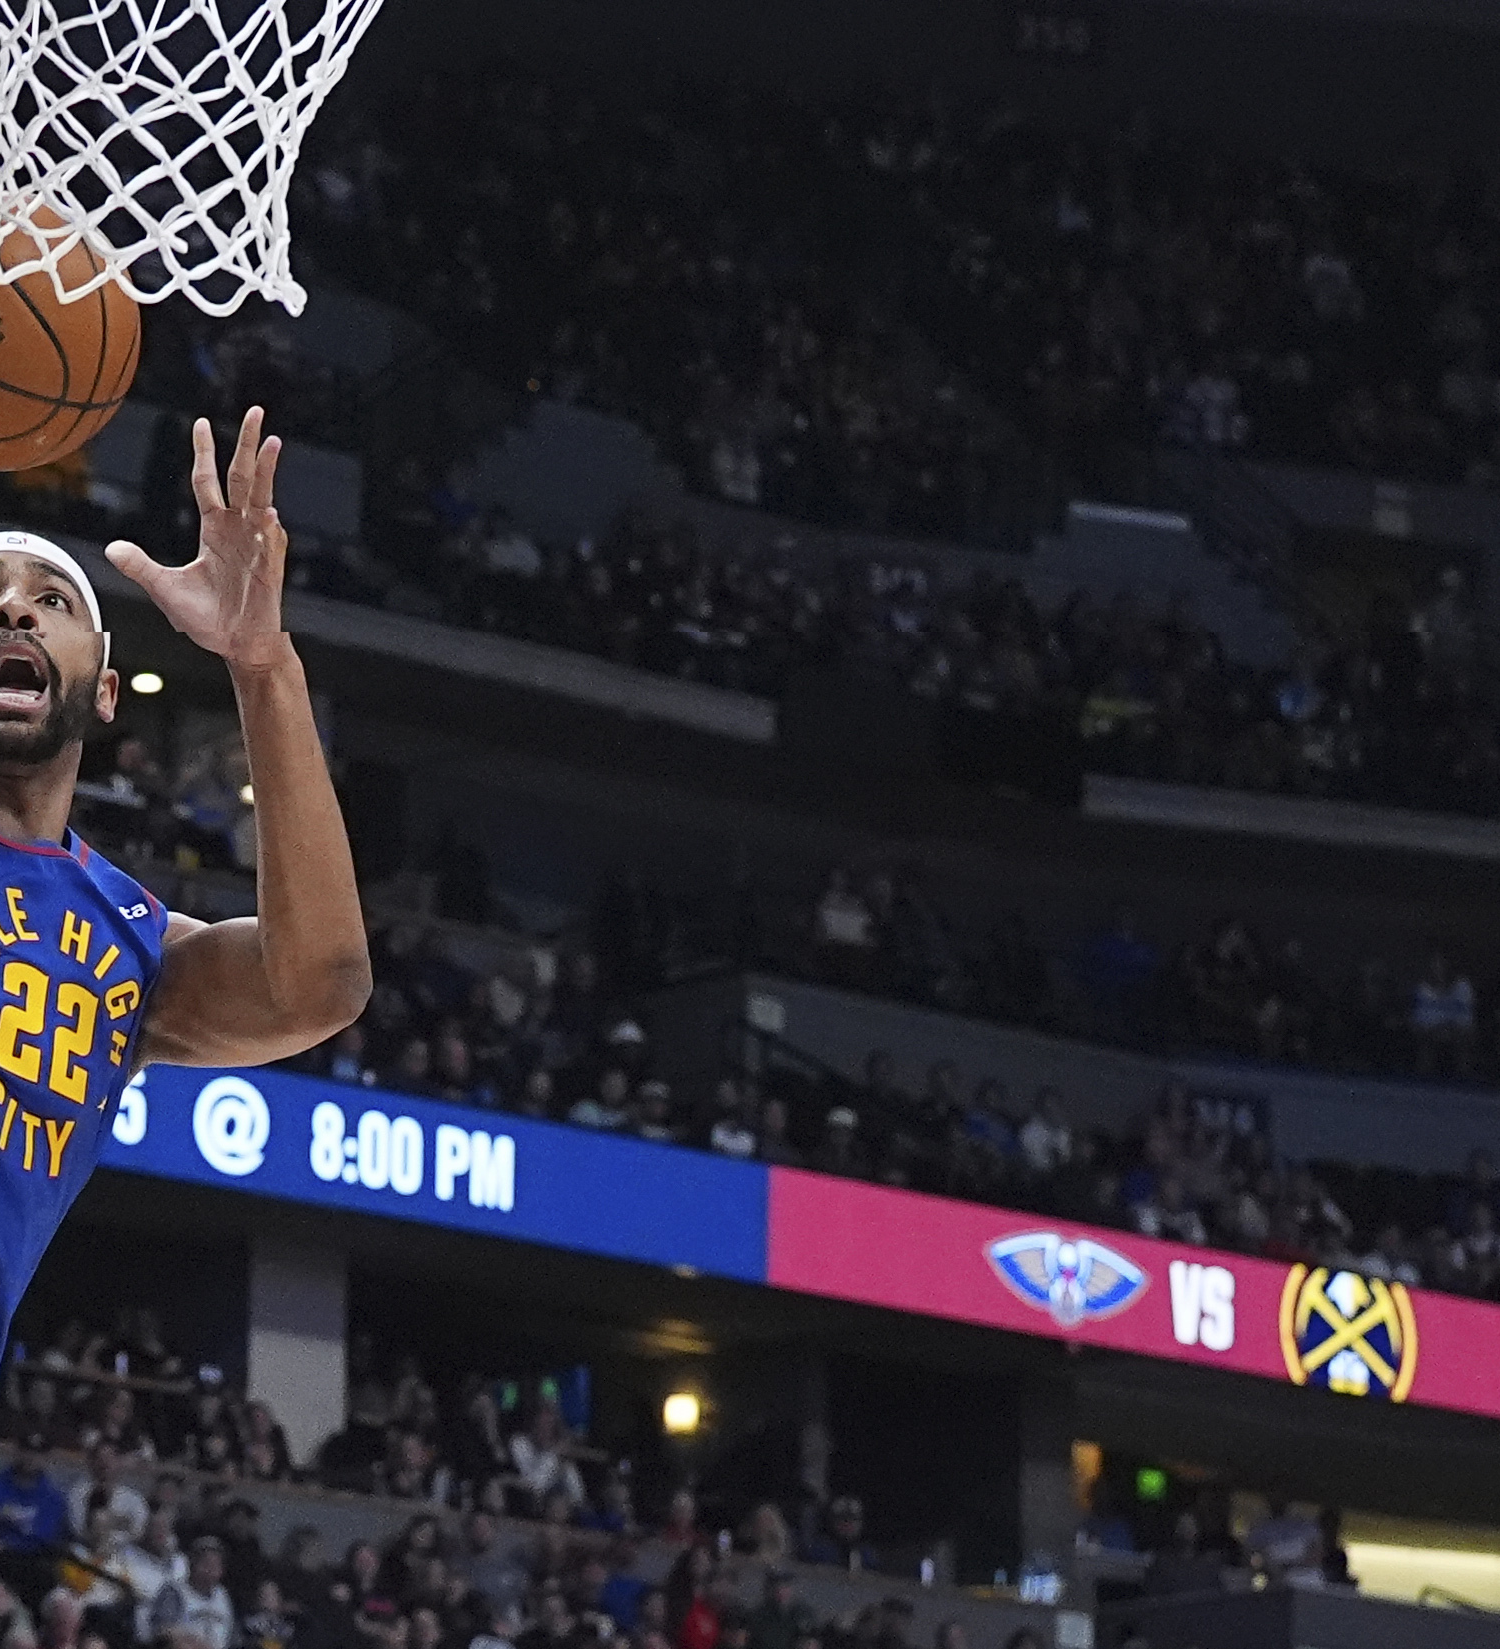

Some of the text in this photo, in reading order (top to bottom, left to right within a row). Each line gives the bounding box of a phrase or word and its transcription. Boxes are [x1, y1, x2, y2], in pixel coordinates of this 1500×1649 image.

[59, 909, 141, 1067] HIGH
[193, 1075, 271, 1176] @
[309, 1101, 425, 1196] 8:00
[434, 1123, 516, 1213] PM
[1169, 1260, 1235, 1351] VS
